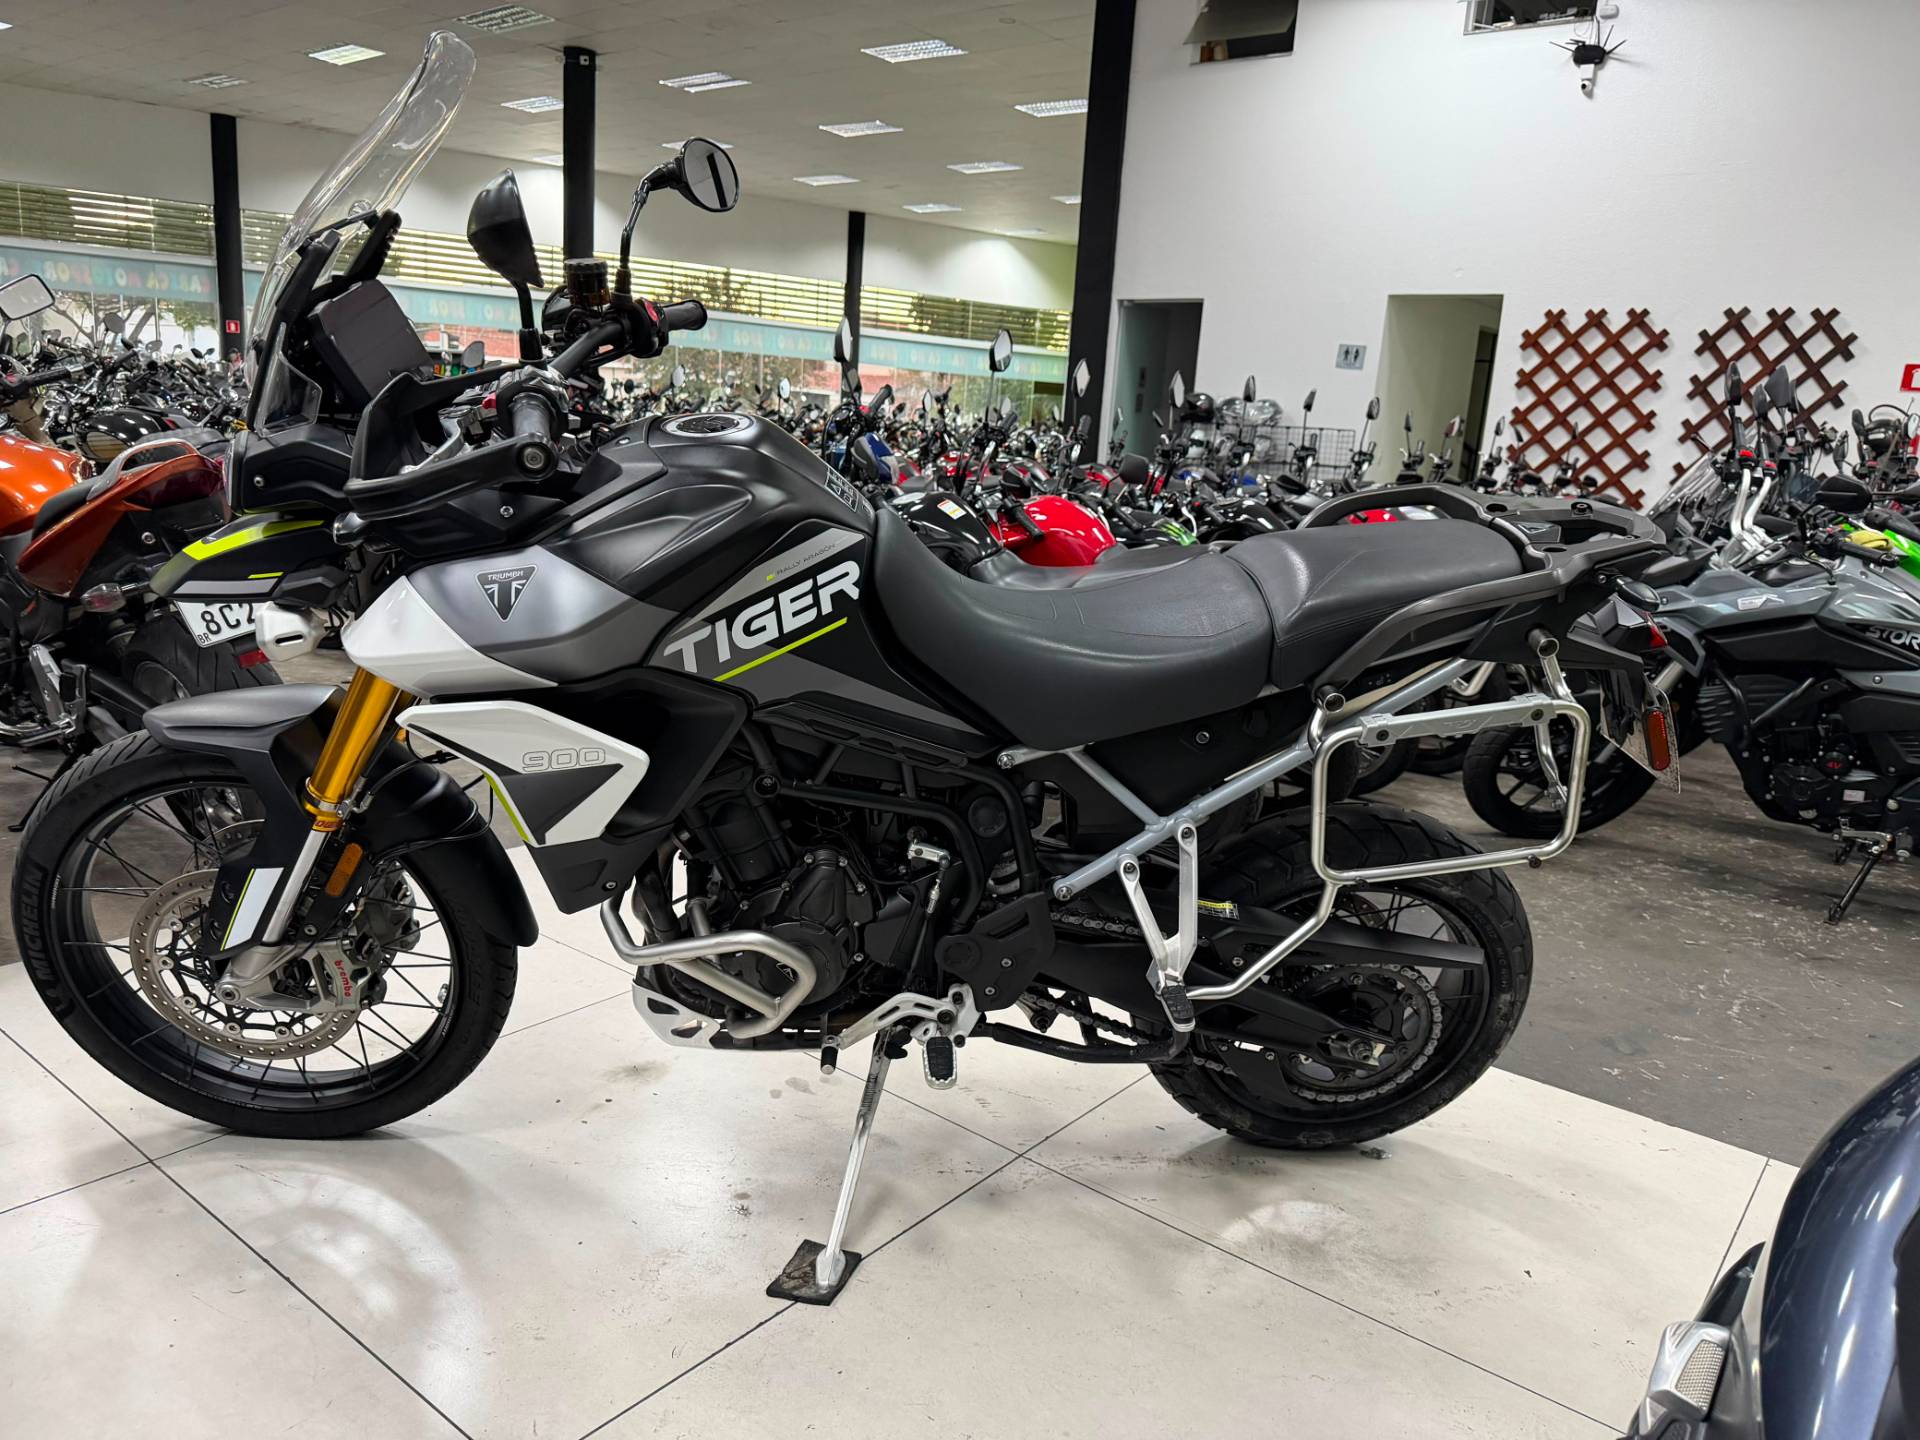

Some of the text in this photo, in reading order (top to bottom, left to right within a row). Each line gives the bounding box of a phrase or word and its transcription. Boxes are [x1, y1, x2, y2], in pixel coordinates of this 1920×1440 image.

[487, 570, 525, 582] TRIUMPH
[663, 560, 861, 674] TIGER
[197, 632, 212, 644] BR
[522, 747, 606, 773] 900
[22, 866, 51, 981] MICHELIN
[334, 959, 353, 998] brembo
